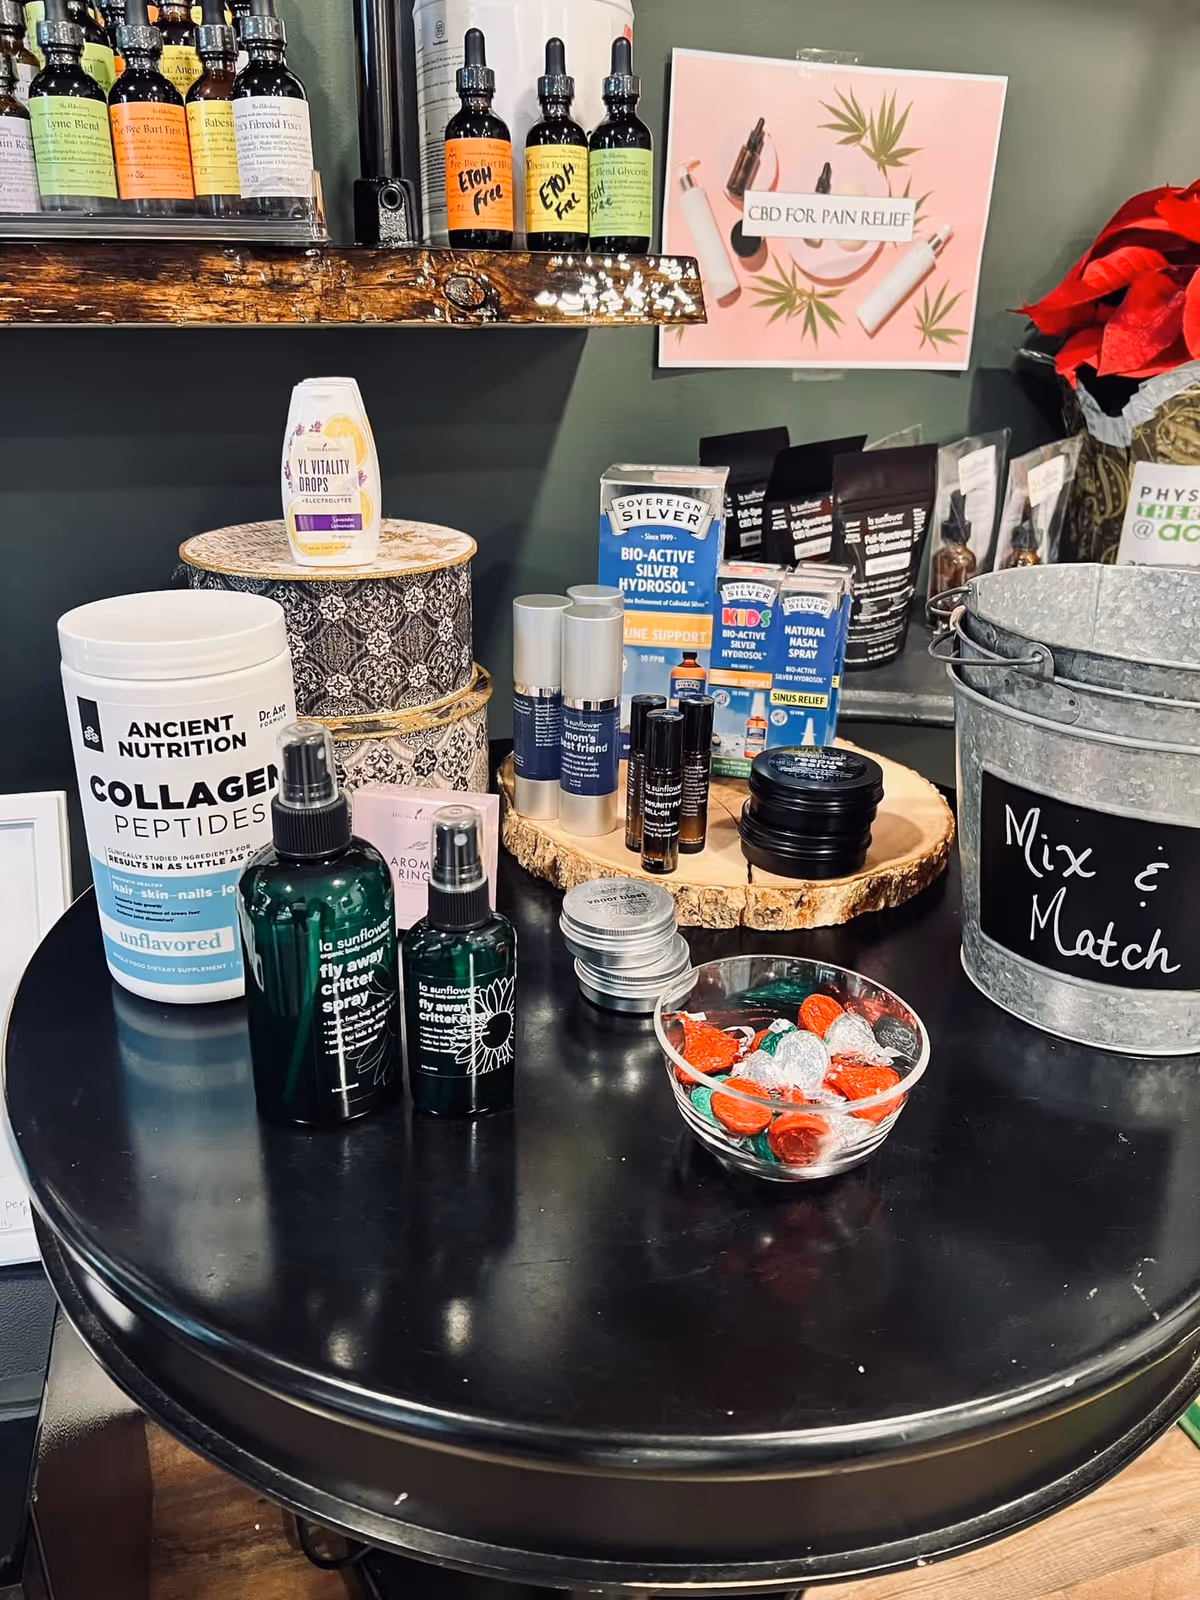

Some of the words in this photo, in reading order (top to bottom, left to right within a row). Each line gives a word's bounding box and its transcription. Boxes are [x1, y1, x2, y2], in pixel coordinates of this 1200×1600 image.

[47, 119, 71, 131] Lyme
[75, 119, 100, 131] Blend
[144, 124, 162, 134] Bart
[249, 119, 280, 130] Fibroid
[458, 166, 492, 193] ETOH
[539, 162, 575, 210] ETOH
[590, 180, 606, 203] TOH
[473, 184, 503, 216] Free
[748, 206, 782, 222] CBD
[786, 207, 817, 224] FOR
[822, 209, 858, 225] PAIN
[860, 211, 912, 227] RELIEF
[298, 459, 308, 474] YL
[311, 459, 350, 474] VITALITY
[298, 476, 329, 492] DROPS
[1140, 486, 1200, 502] PHYS
[618, 498, 702, 513] SOVEREIGN
[622, 509, 700, 526] SILVER
[644, 532, 659, 541] Since
[620, 547, 696, 564] BIO-ACTIVE
[635, 563, 678, 579] SILVER
[728, 590, 770, 600] SILVER
[788, 604, 828, 612] SILVER
[722, 608, 772, 628] KIDS
[652, 629, 708, 643] SUPPORT
[722, 630, 766, 640] BIO-ACTIVE
[784, 625, 826, 638] NATURAL
[730, 640, 756, 650] SILVER
[789, 637, 818, 648] NASAL
[650, 655, 666, 664] PPM
[788, 648, 818, 660] SPRAY
[775, 673, 793, 682] SILVER
[786, 666, 816, 675] BIO-ACTIVE
[772, 692, 797, 703] SINUS
[798, 695, 825, 705] RELIEF
[258, 708, 272, 722] Dr.
[272, 704, 286, 717] Axe
[260, 712, 287, 728] FORMULA
[128, 714, 234, 738] ANCIENT
[569, 720, 602, 728] sunflower
[118, 732, 247, 758] NUTRITION
[565, 731, 596, 744] mom's
[576, 742, 608, 754] friend
[114, 802, 266, 838] PEPTIDES
[1005, 803, 1097, 879] Mix
[108, 847, 142, 860] CLINICALLY
[145, 854, 178, 862] STUDIED
[180, 850, 234, 861] INGREDIENTS
[236, 844, 251, 852] FOR
[108, 854, 148, 869] RESULTS
[152, 862, 163, 870] IN
[168, 862, 182, 870] AS
[186, 858, 226, 869] LITTLE
[230, 854, 244, 863] AS
[390, 856, 430, 870] AROM
[319, 939, 333, 952] la
[336, 915, 392, 949] sunflower
[1030, 886, 1182, 974] Match
[120, 931, 222, 952] unflavored
[344, 945, 360, 954] body
[129, 960, 146, 969] FOOD
[146, 964, 177, 973] DIETARY
[178, 963, 226, 974] SUPPLEMENT
[319, 963, 344, 980] fly
[346, 946, 384, 972] away
[321, 970, 375, 996] critter
[418, 982, 428, 992] la
[430, 985, 480, 994] sunflower
[322, 990, 369, 1014] spray
[418, 998, 434, 1012] fly
[436, 1003, 468, 1014] away
[418, 1012, 456, 1024] critter
